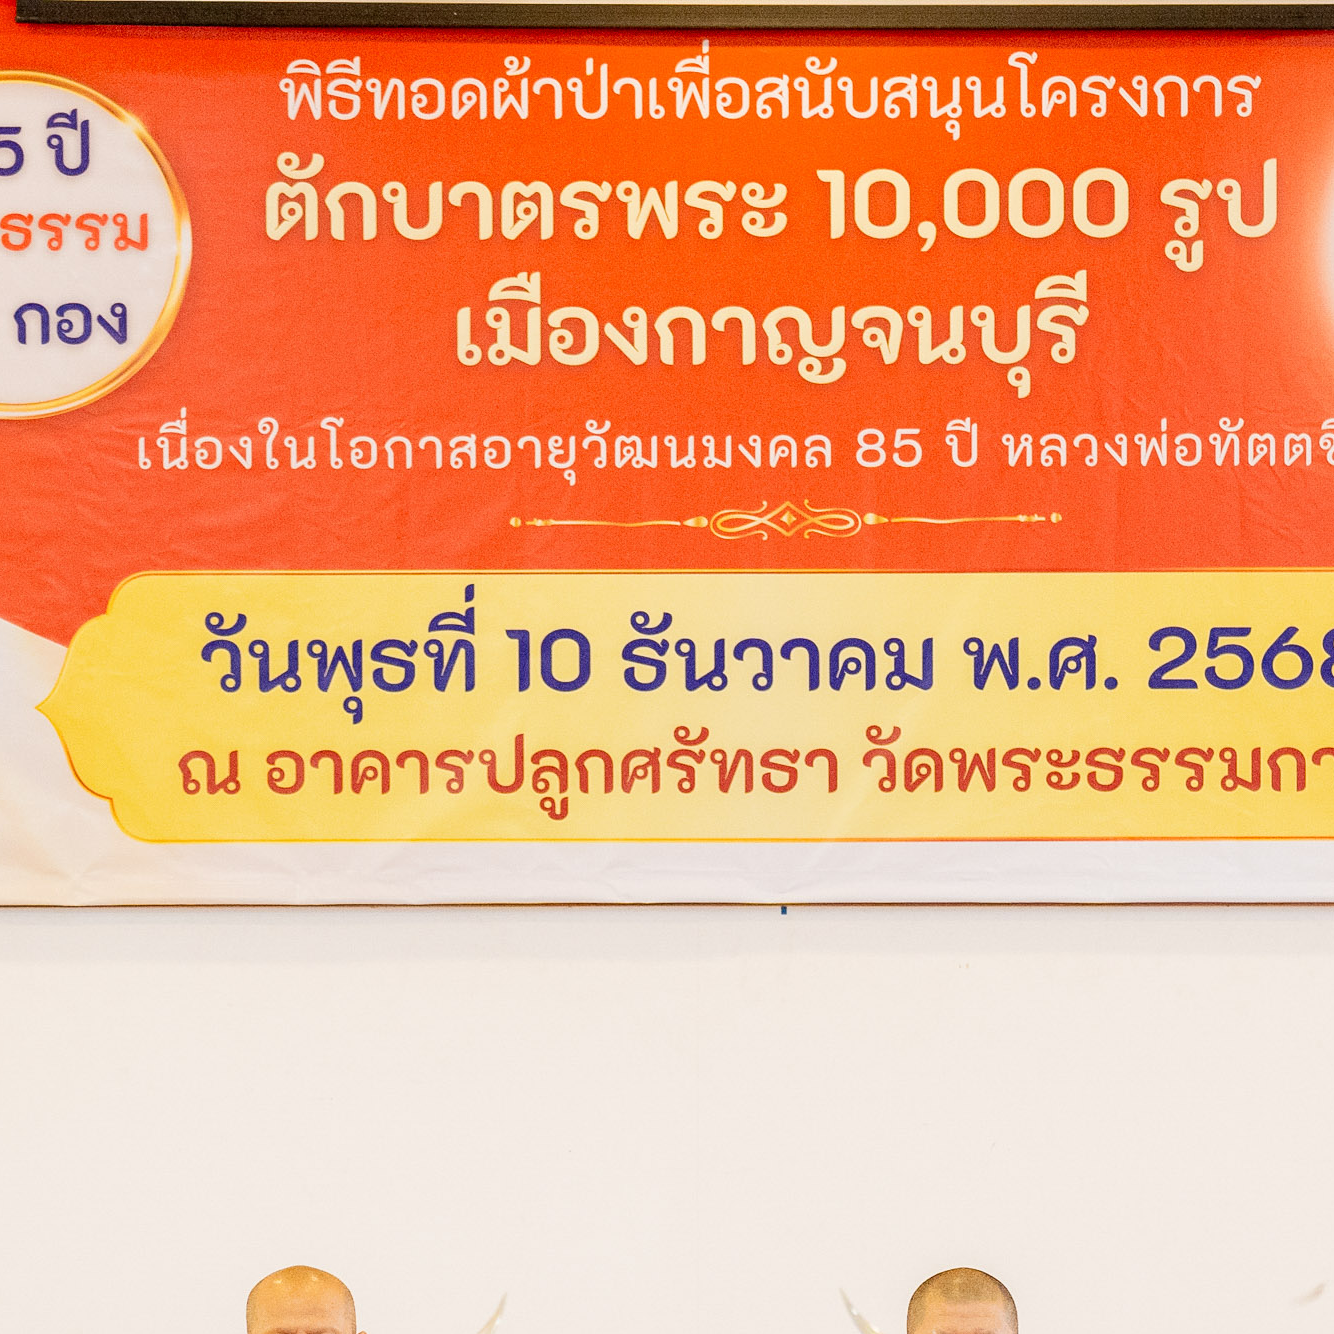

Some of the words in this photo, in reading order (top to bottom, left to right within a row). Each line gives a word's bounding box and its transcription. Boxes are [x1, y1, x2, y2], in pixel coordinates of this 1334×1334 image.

[279, 39, 1262, 141] พิธีทอดผ้าป่าเพื่อสนับสนุนโครงการ
[46, 108, 90, 176] ปี
[265, 151, 787, 243] ตักบาตรพระ
[818, 166, 1130, 258] 10,000
[1161, 159, 1279, 272] รูป
[14, 302, 128, 345] กอง
[456, 270, 1090, 396] เมืองกาญจนบุรี
[137, 407, 833, 486] เนื่องในโอกาสอายุวัฒนมงคล
[855, 428, 924, 468] 85
[946, 418, 979, 468] ปี
[201, 584, 477, 725] วันพุธที่
[506, 629, 592, 693] 10
[622, 611, 937, 694] ธันวาคม
[963, 635, 1119, 693] พ.ศ.
[176, 743, 240, 797] ณ
[265, 725, 839, 822] อาคารปลูกศรัทธา
